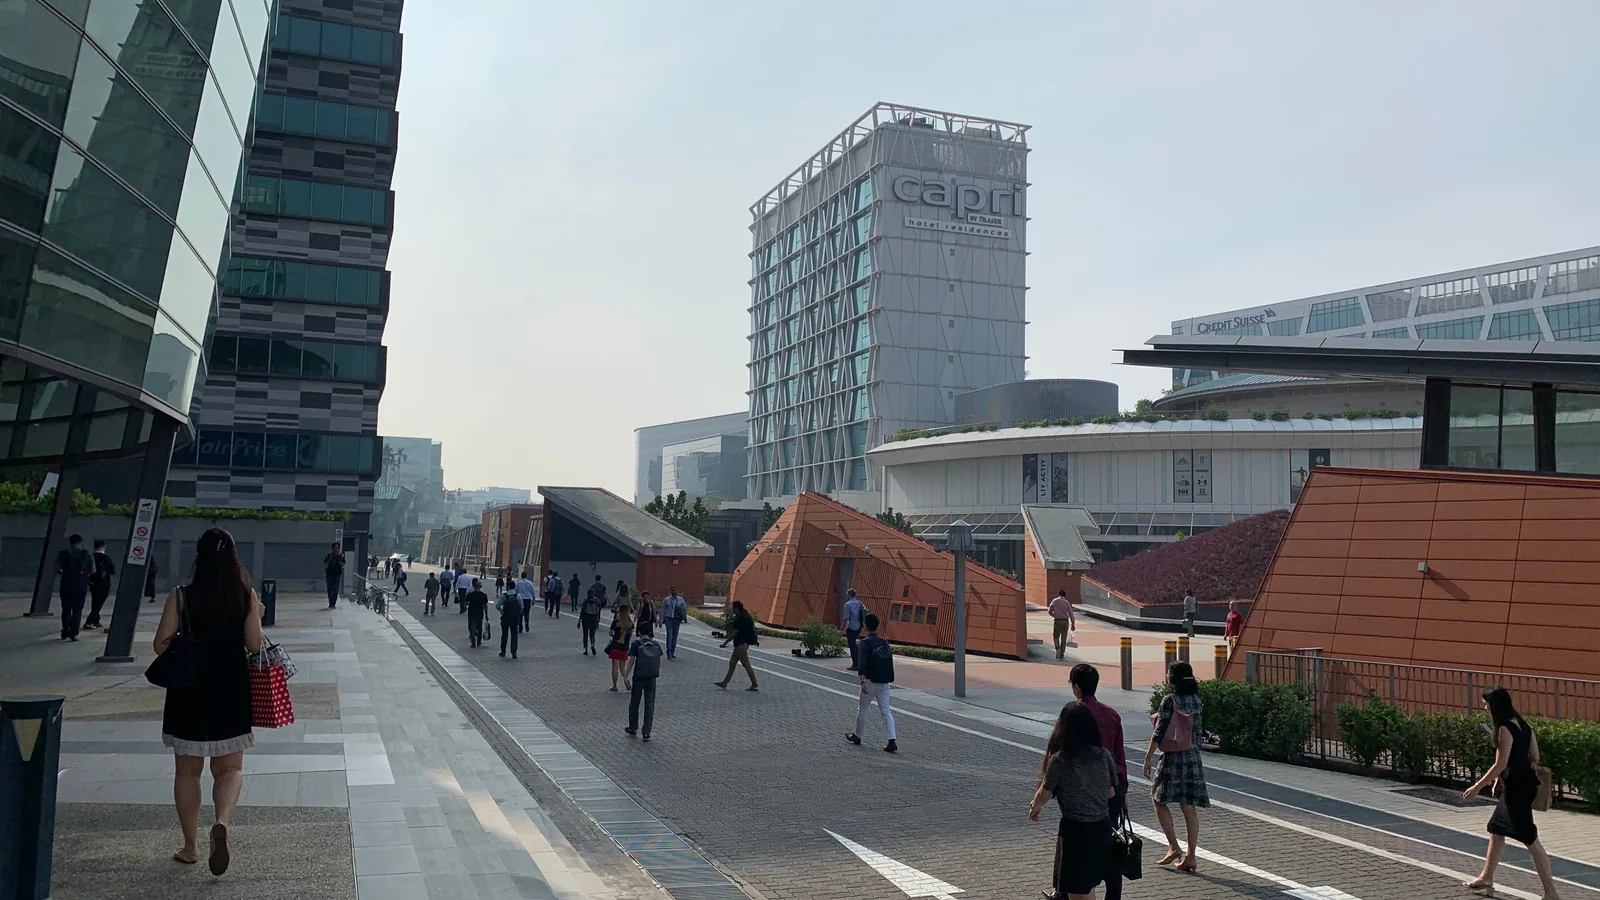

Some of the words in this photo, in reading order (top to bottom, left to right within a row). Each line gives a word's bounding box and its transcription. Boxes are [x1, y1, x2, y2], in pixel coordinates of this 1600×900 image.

[893, 175, 1022, 219] capri
[908, 219, 939, 228] hotel
[945, 223, 1009, 237] residences
[979, 216, 1002, 224] FRASER
[1197, 320, 1232, 334] CREDIT
[1233, 314, 1266, 328] SUISSE
